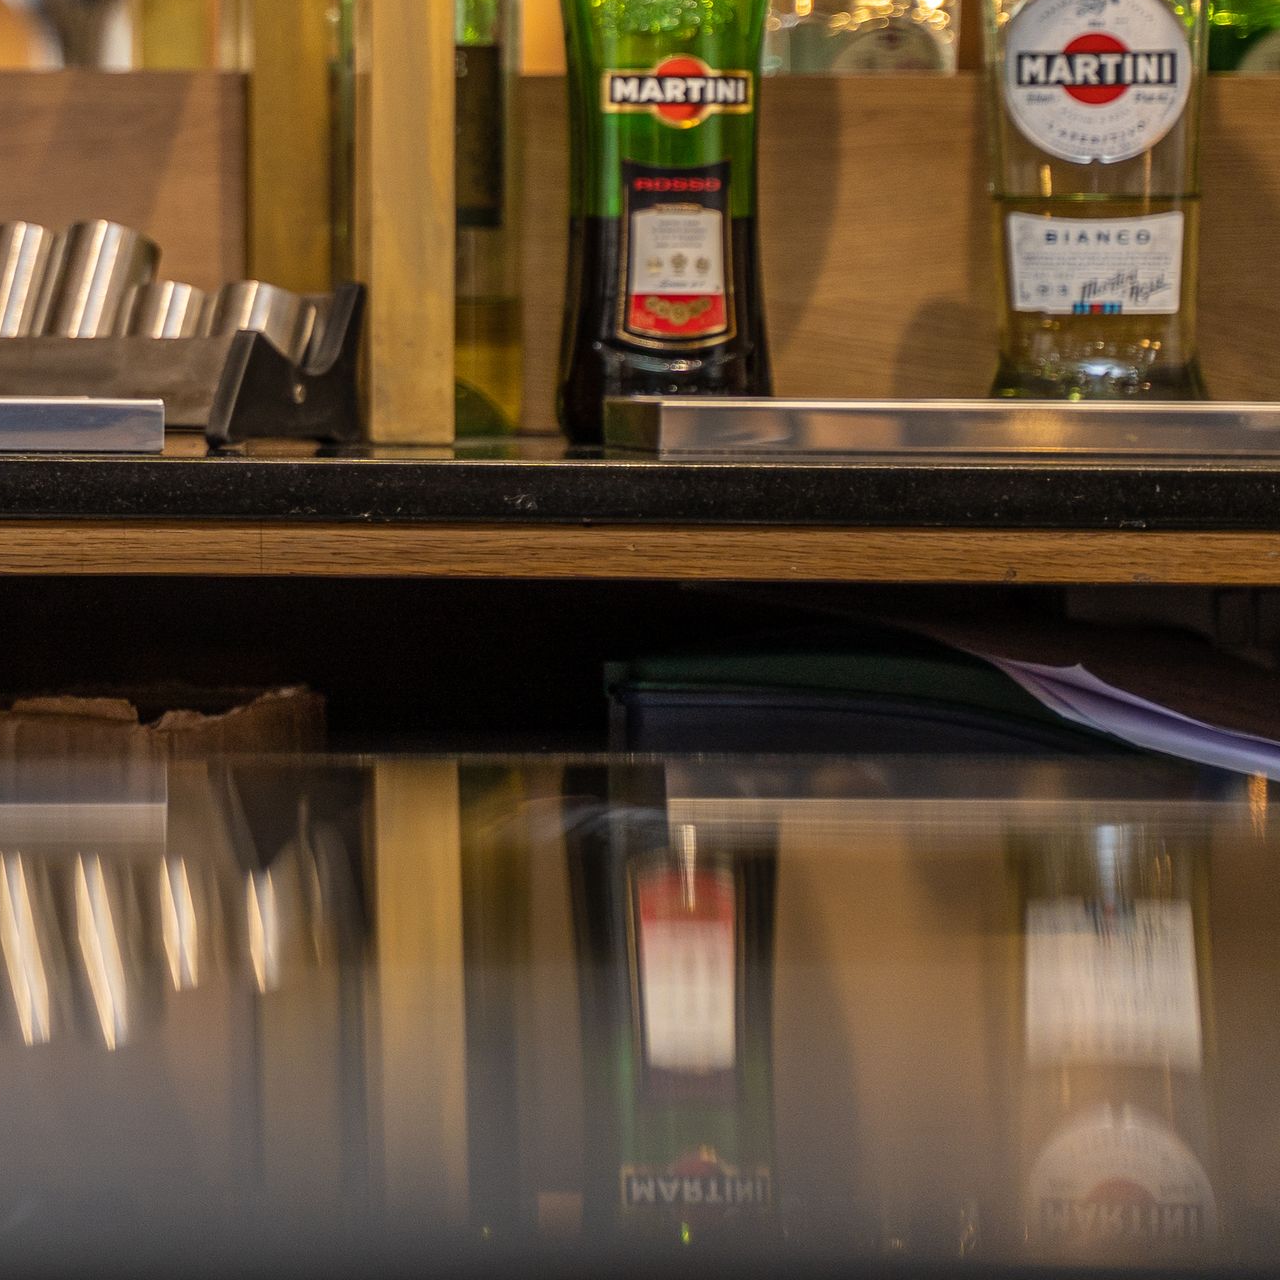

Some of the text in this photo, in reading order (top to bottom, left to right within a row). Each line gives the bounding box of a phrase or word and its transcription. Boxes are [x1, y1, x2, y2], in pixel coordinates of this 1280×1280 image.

[1020, 53, 1173, 85] MARTINI
[611, 76, 746, 104] MARTINI
[1043, 228, 1152, 246] BIANCO
